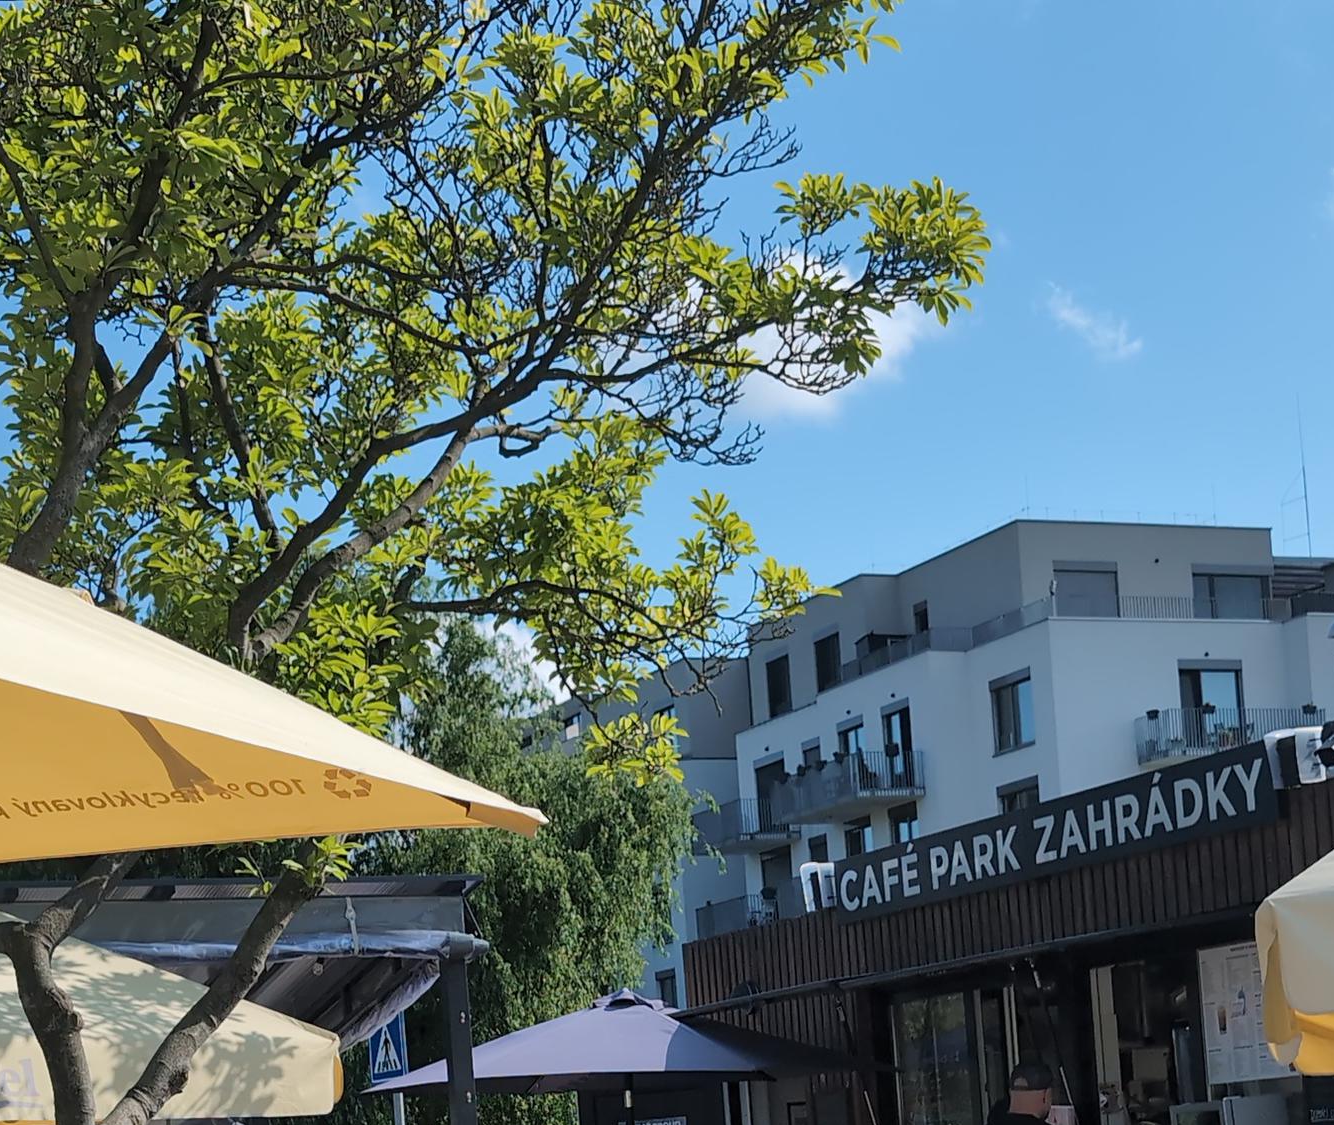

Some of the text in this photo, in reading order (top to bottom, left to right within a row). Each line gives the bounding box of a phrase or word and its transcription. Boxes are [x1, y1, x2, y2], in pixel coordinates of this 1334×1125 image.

[838, 756, 1264, 912] CAFÉ PARK ZAHRÁDKY
